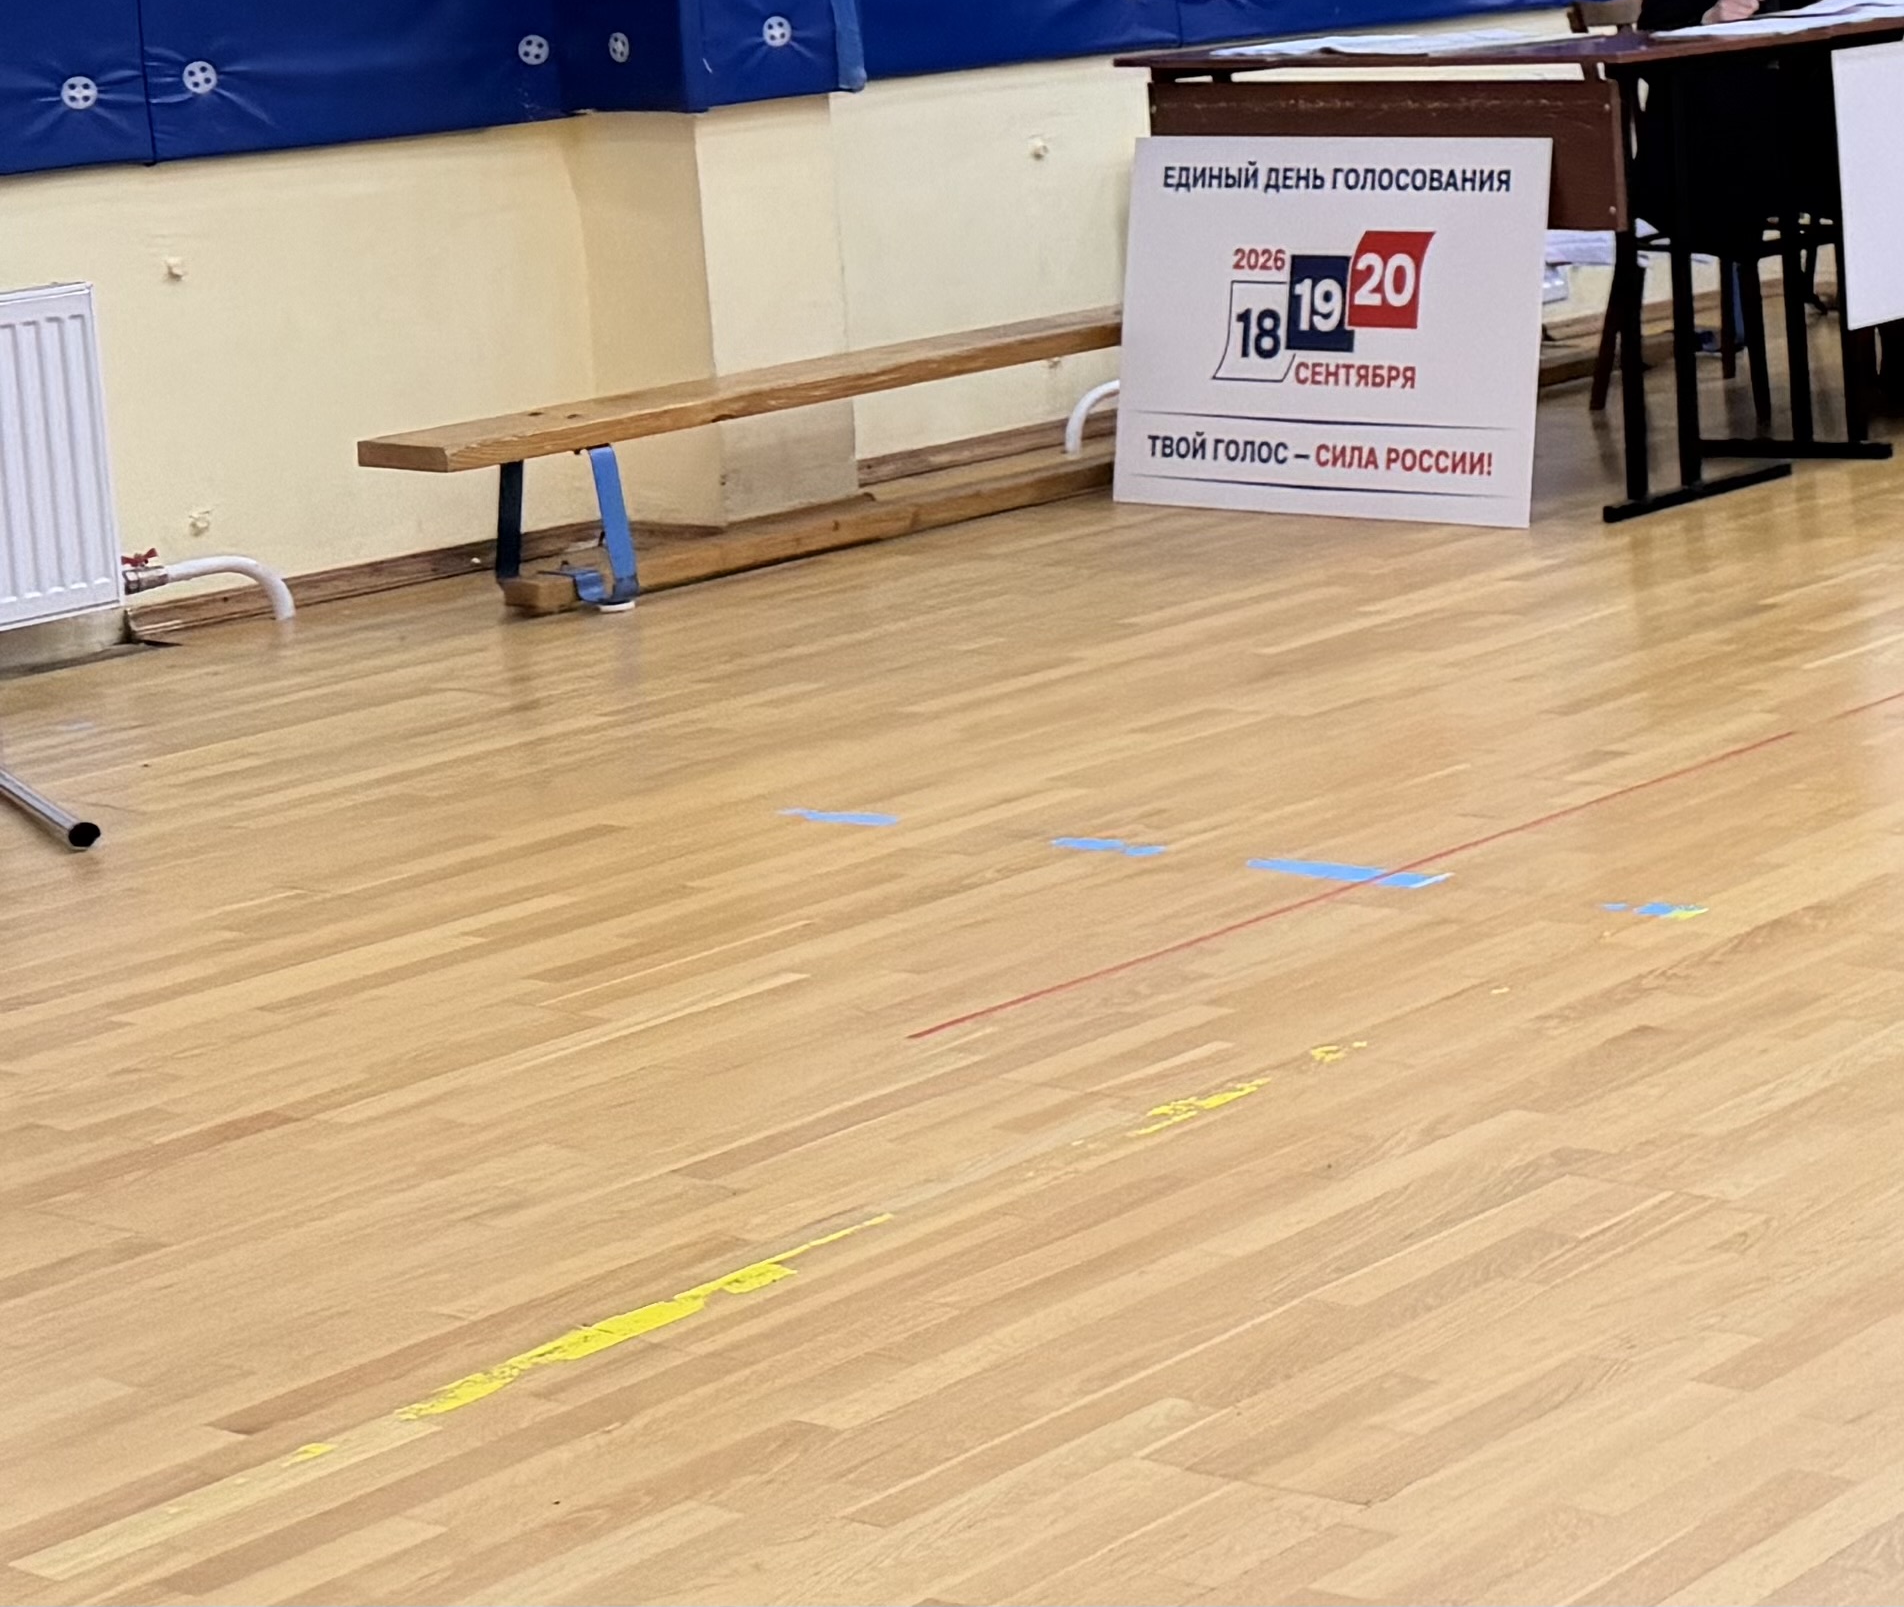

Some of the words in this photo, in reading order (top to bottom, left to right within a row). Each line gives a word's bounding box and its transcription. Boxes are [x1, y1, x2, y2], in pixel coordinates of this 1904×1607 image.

[1162, 162, 1258, 192] ЕДИНЫЙ
[1263, 168, 1326, 193] ДЕНЬ
[1330, 167, 1512, 193] ГОЛОСОВАНИЯ
[1232, 247, 1286, 271] 2026
[1236, 308, 1282, 359] 18
[1294, 278, 1342, 332] 19
[1354, 252, 1417, 307] 20
[1294, 362, 1417, 390] СЕНТЯБРЯ
[1147, 431, 1208, 462] ТВОЙ
[1212, 437, 1289, 465] ГОЛОС
[1315, 443, 1379, 471] СИЛА
[1386, 447, 1493, 476] РОССИИ!
